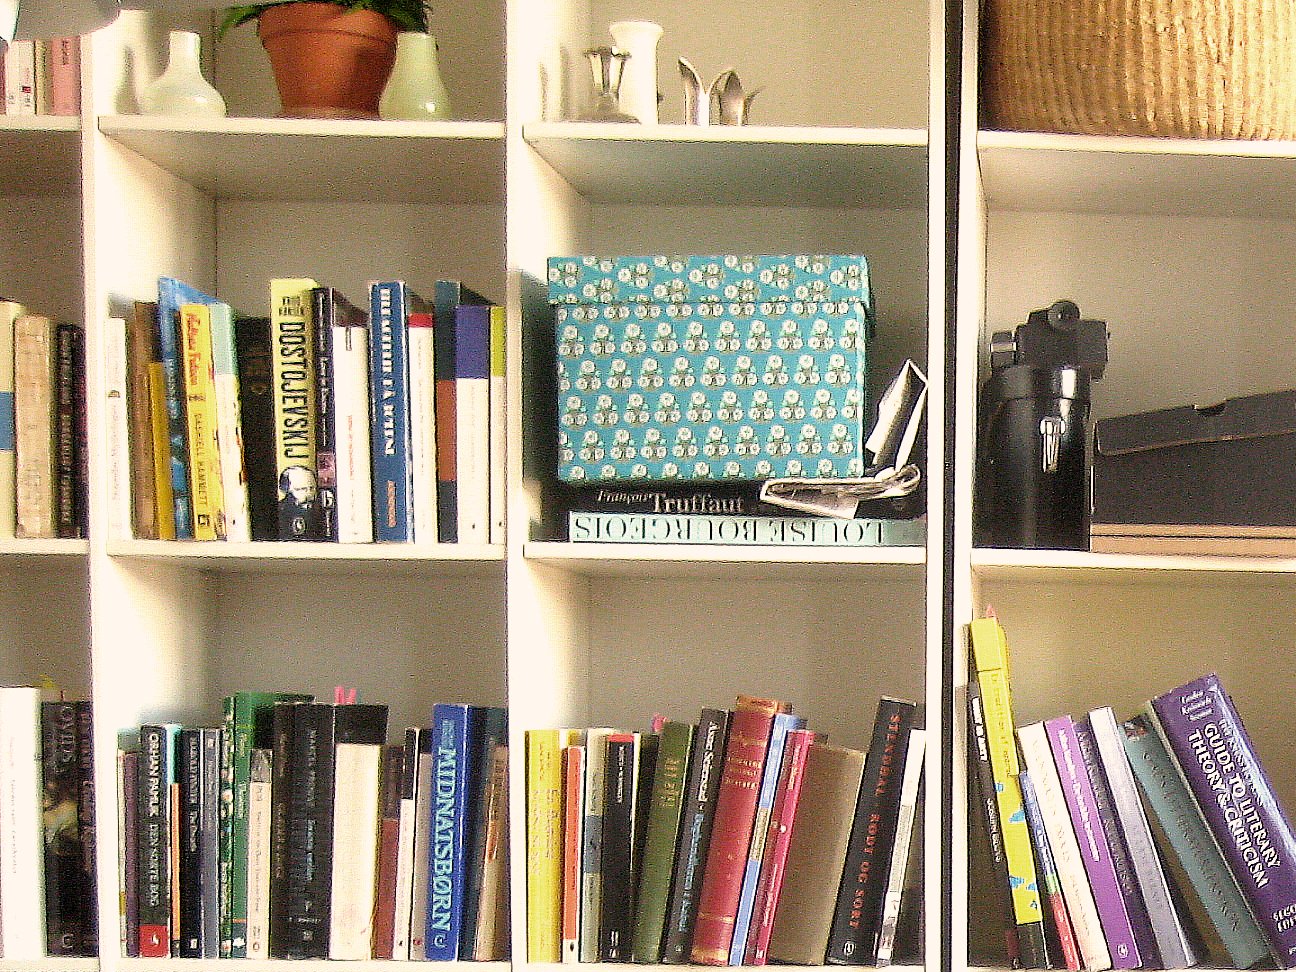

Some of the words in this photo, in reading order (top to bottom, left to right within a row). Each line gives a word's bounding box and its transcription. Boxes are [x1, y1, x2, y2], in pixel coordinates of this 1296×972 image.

[279, 321, 309, 459] DOSTOJEVSKIJ
[575, 516, 758, 542] BOURGEOIS
[651, 493, 744, 513] Truffaut
[769, 517, 885, 545] LOUISE
[149, 733, 161, 776] ORHAN
[875, 713, 902, 798] STENDHAL
[1187, 729, 1229, 795] THEORY
[149, 778, 161, 817] PAMUK
[1204, 722, 1234, 774] GUIDE
[1228, 774, 1246, 800] TO
[1241, 798, 1281, 869] LITERARY
[1215, 792, 1231, 808] &
[431, 748, 456, 933] MIDNATSBØRN
[1222, 805, 1270, 889] CRITICISM
